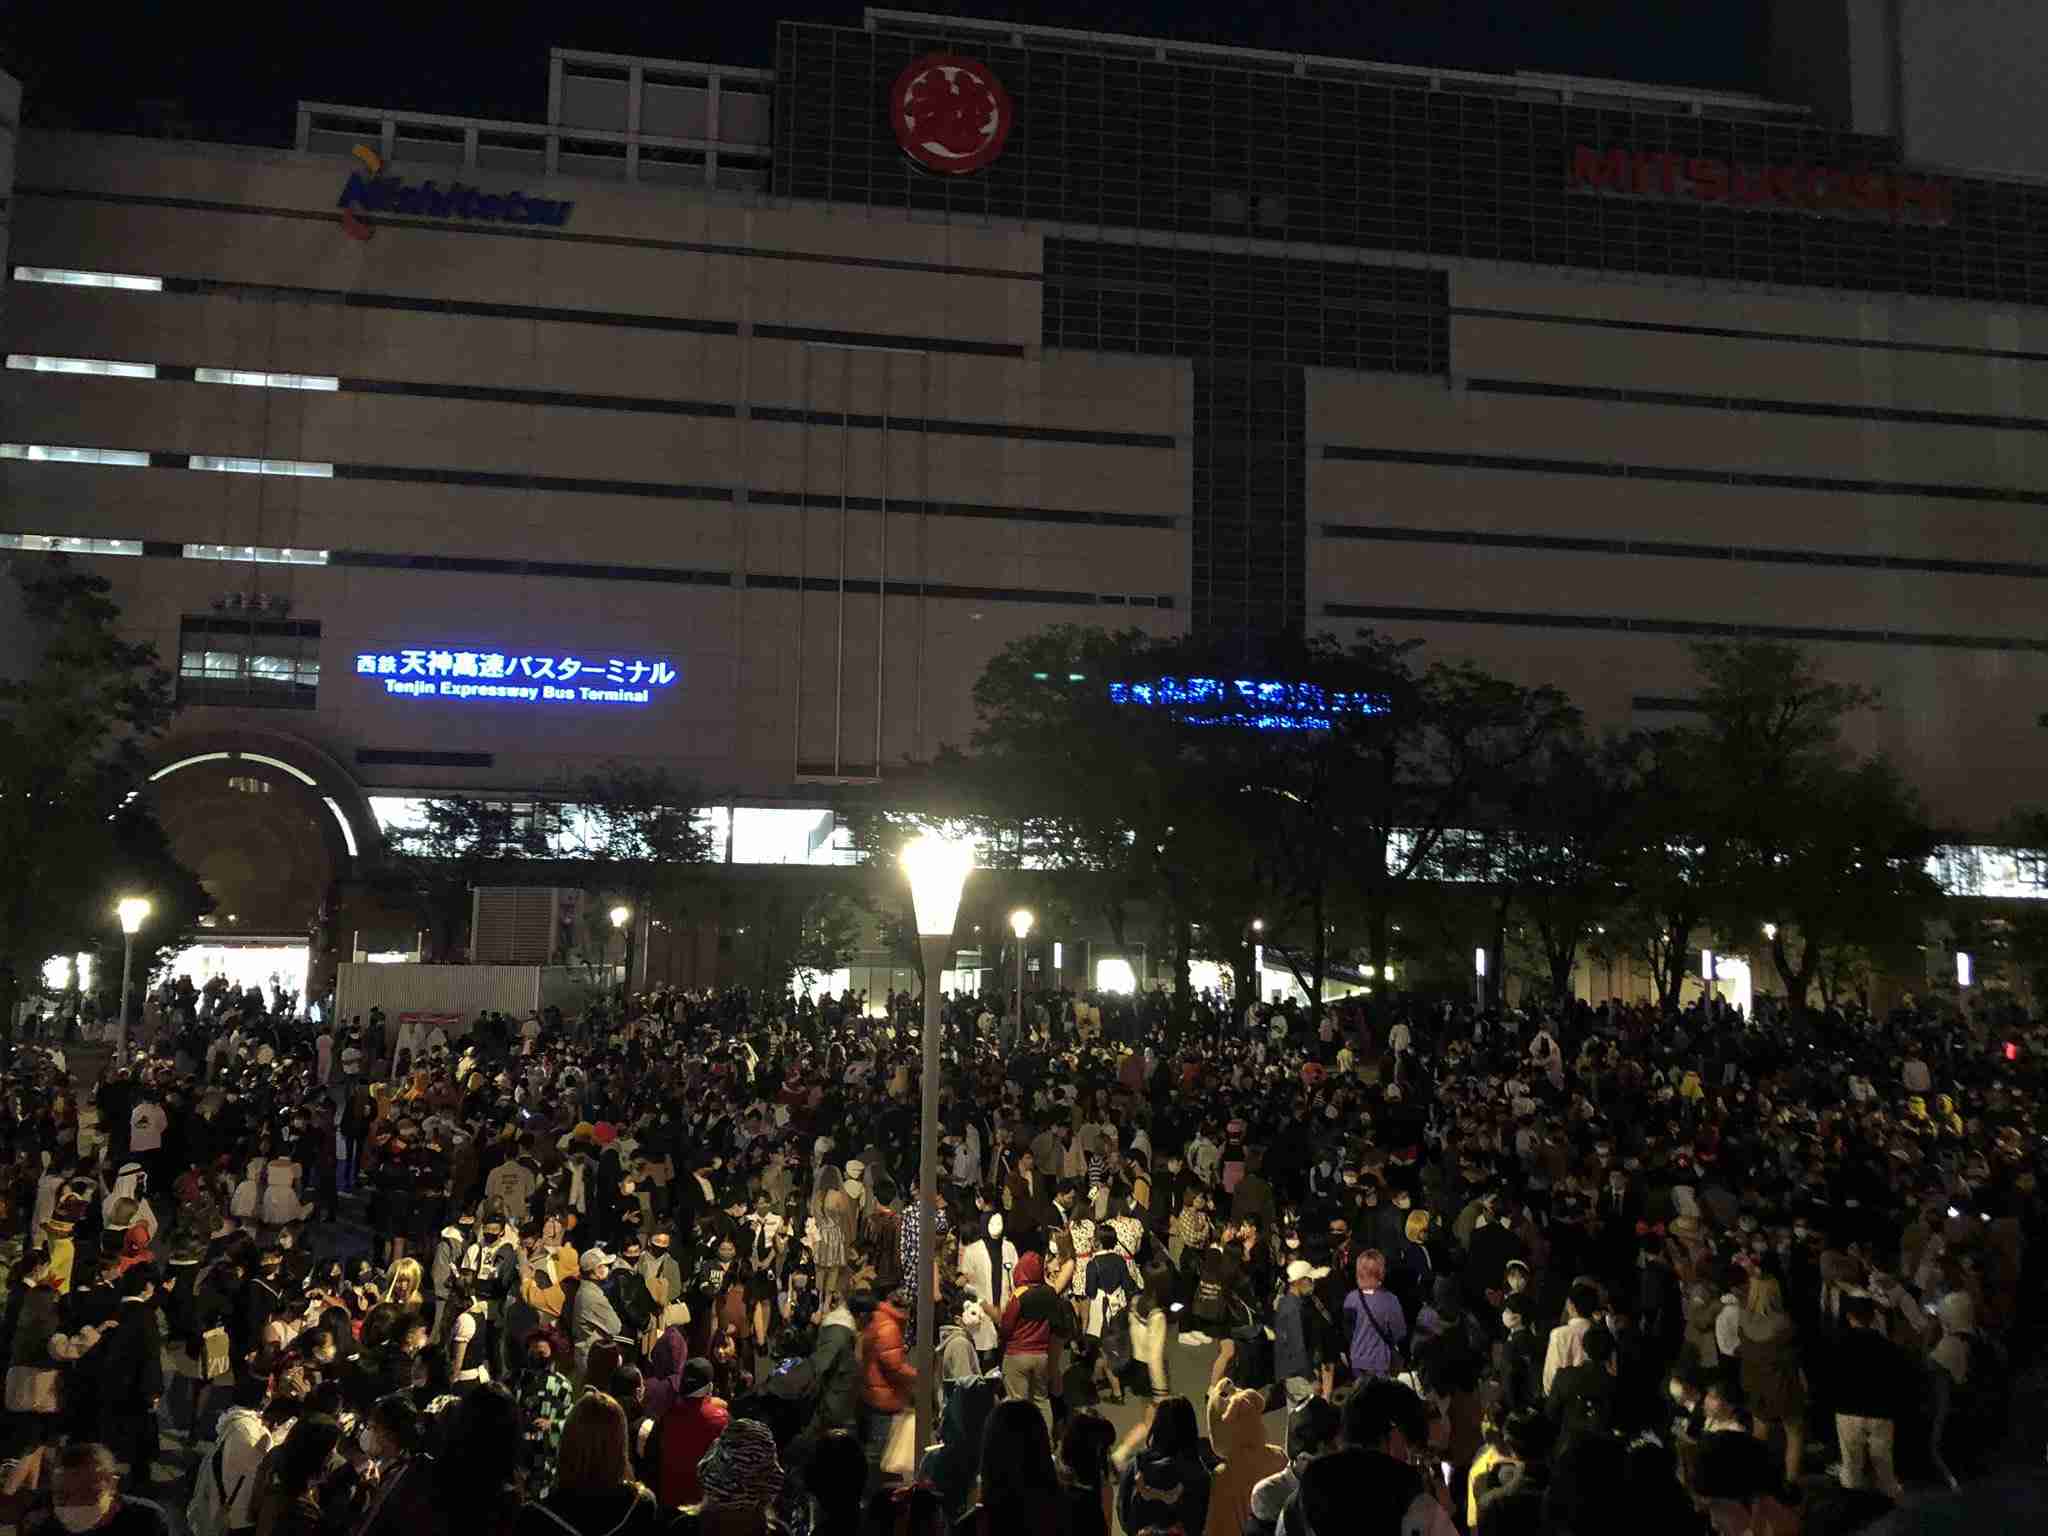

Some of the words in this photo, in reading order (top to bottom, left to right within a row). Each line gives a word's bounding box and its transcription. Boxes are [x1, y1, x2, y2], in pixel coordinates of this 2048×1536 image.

[385, 679, 436, 697] Tenjin
[440, 681, 539, 698] Expressway
[542, 685, 577, 700] Bus
[579, 687, 650, 703] Terminal
